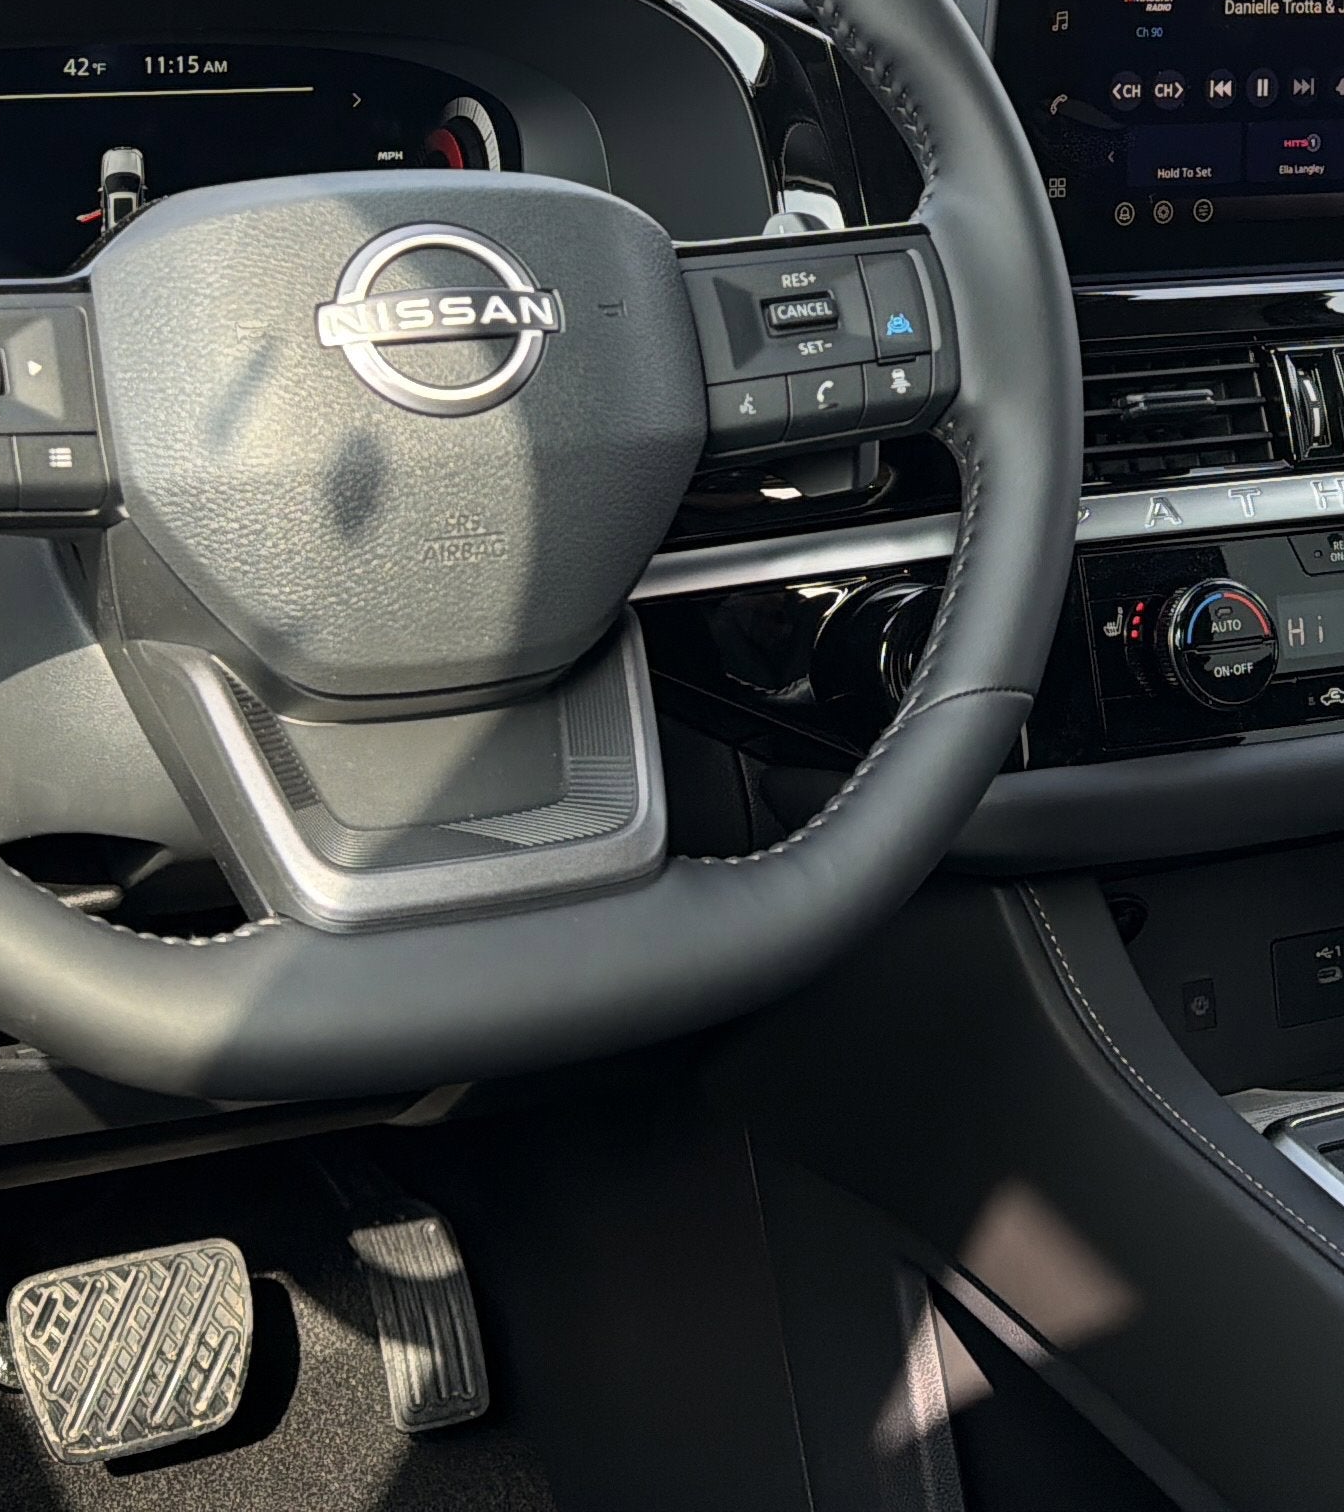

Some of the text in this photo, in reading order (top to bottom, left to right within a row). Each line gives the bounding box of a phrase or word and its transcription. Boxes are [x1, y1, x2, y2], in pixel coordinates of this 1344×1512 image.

[1225, 0, 1279, 15] Danielle
[1325, 0, 1335, 14] &
[1136, 27, 1163, 38] Ch 90
[144, 55, 199, 74] 11:15
[203, 60, 228, 73] AM
[377, 151, 403, 161] MPH
[1157, 167, 1212, 178] Hold To Set
[1279, 164, 1325, 175] Ella Langley
[781, 272, 816, 288] RES+
[326, 295, 554, 337] NISSAN
[777, 301, 832, 319] CANCEL
[423, 538, 506, 563] AIRBAG
[1211, 619, 1241, 633] AUTO
